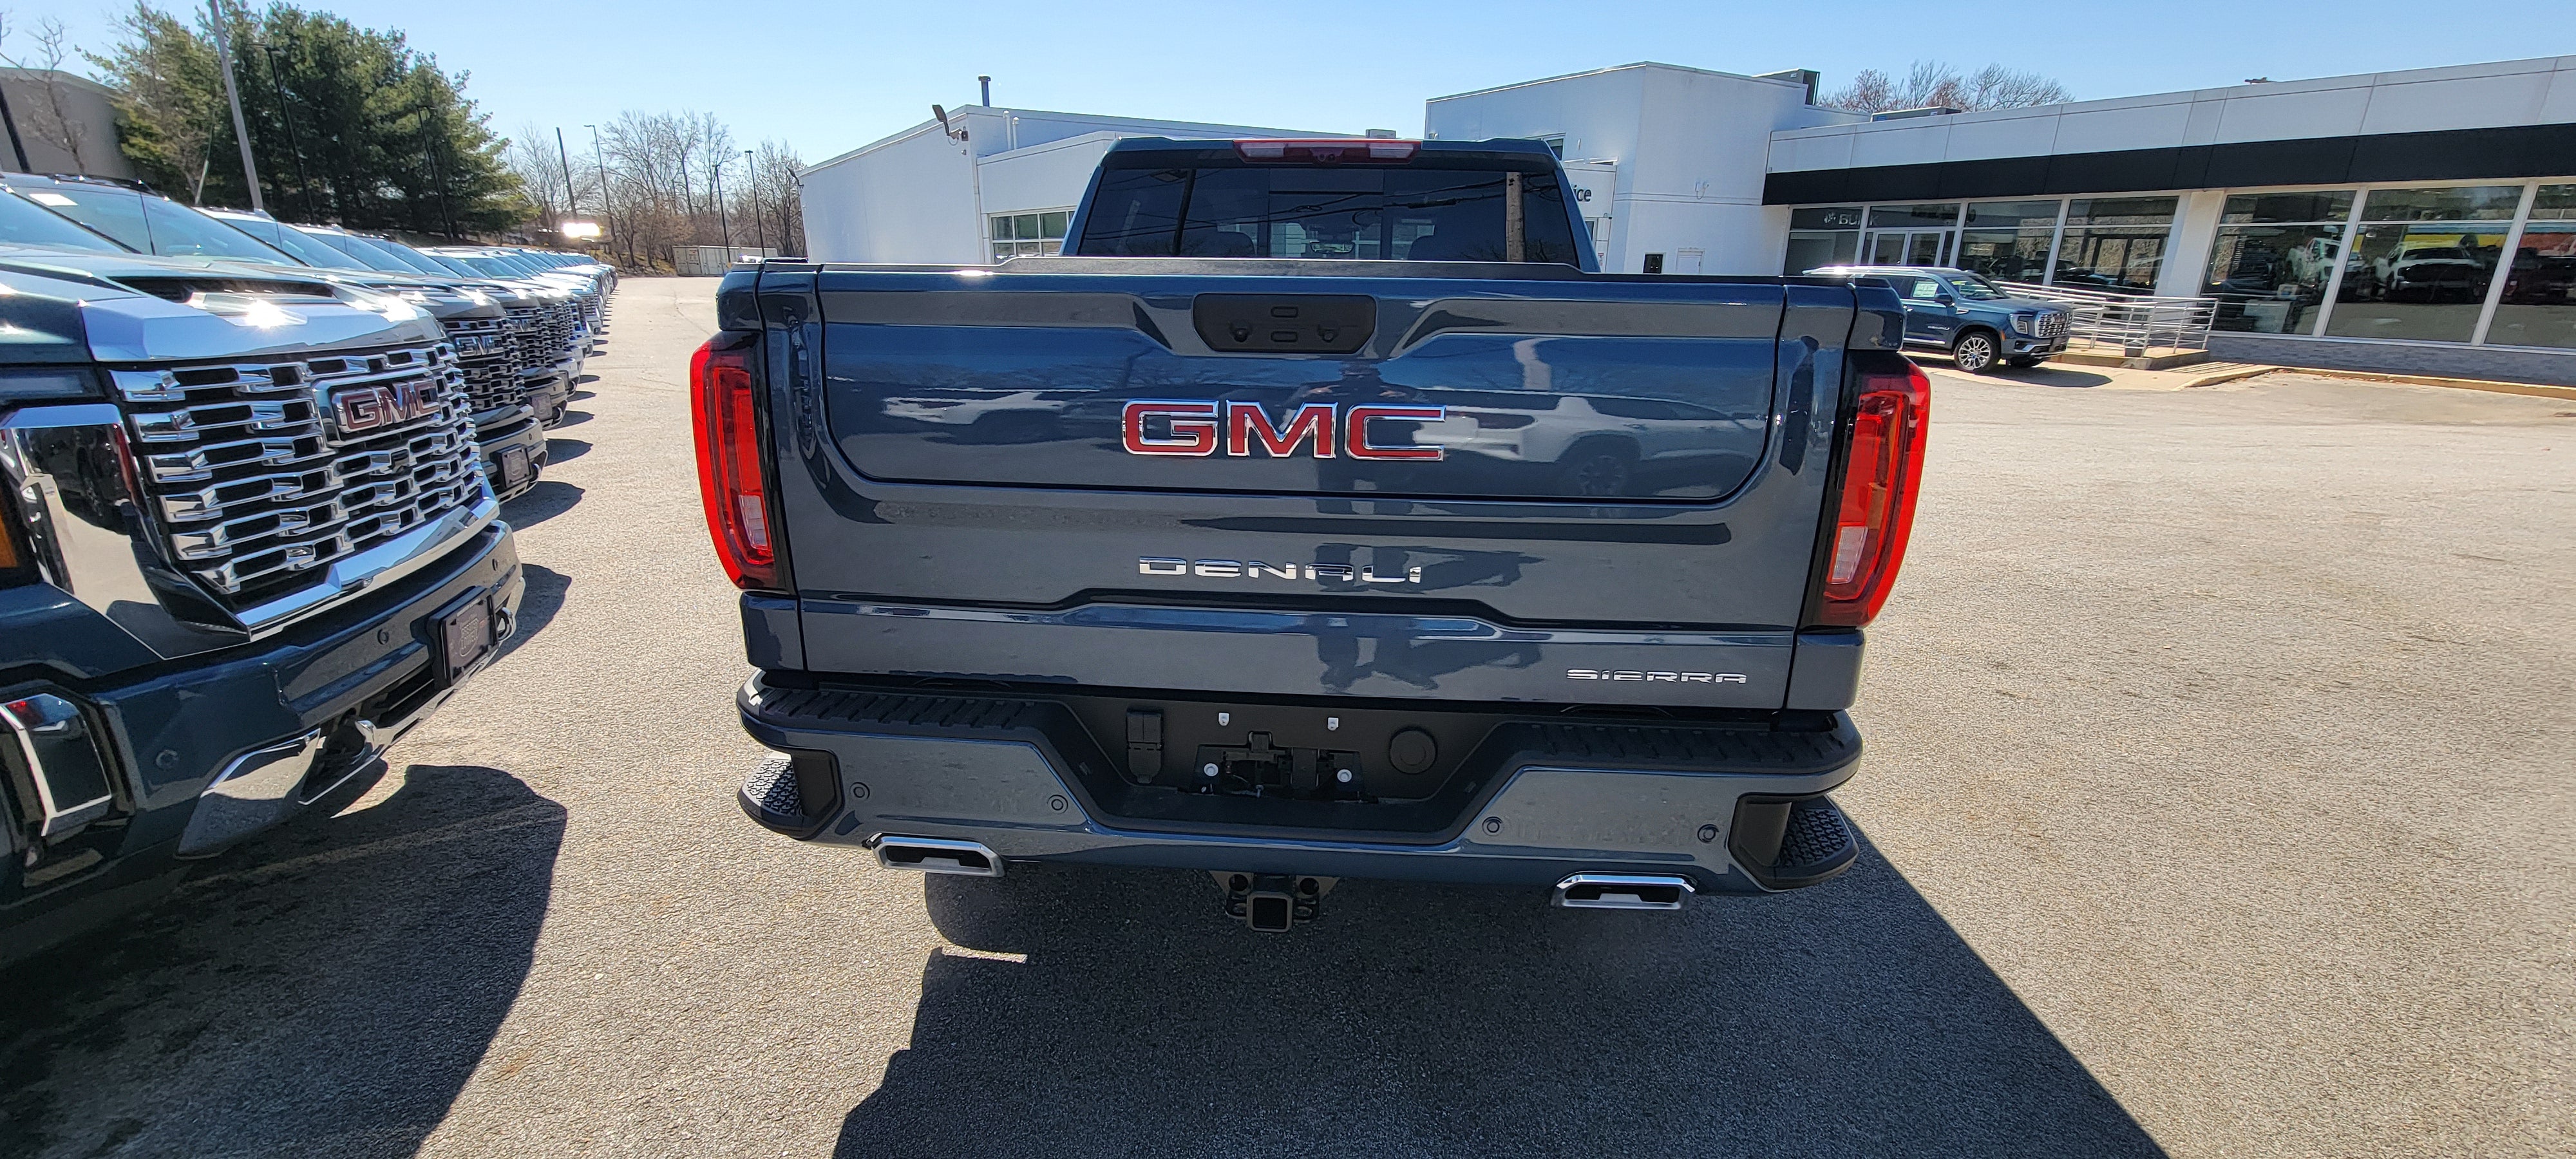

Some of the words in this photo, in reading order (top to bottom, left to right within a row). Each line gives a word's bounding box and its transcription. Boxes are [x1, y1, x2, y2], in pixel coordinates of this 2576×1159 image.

[1839, 213, 1879, 226] BUIK
[332, 377, 440, 433] GMC
[1122, 399, 1446, 462] GMC
[1139, 556, 1421, 584] DENALI
[1566, 669, 1747, 684] SIERRA
